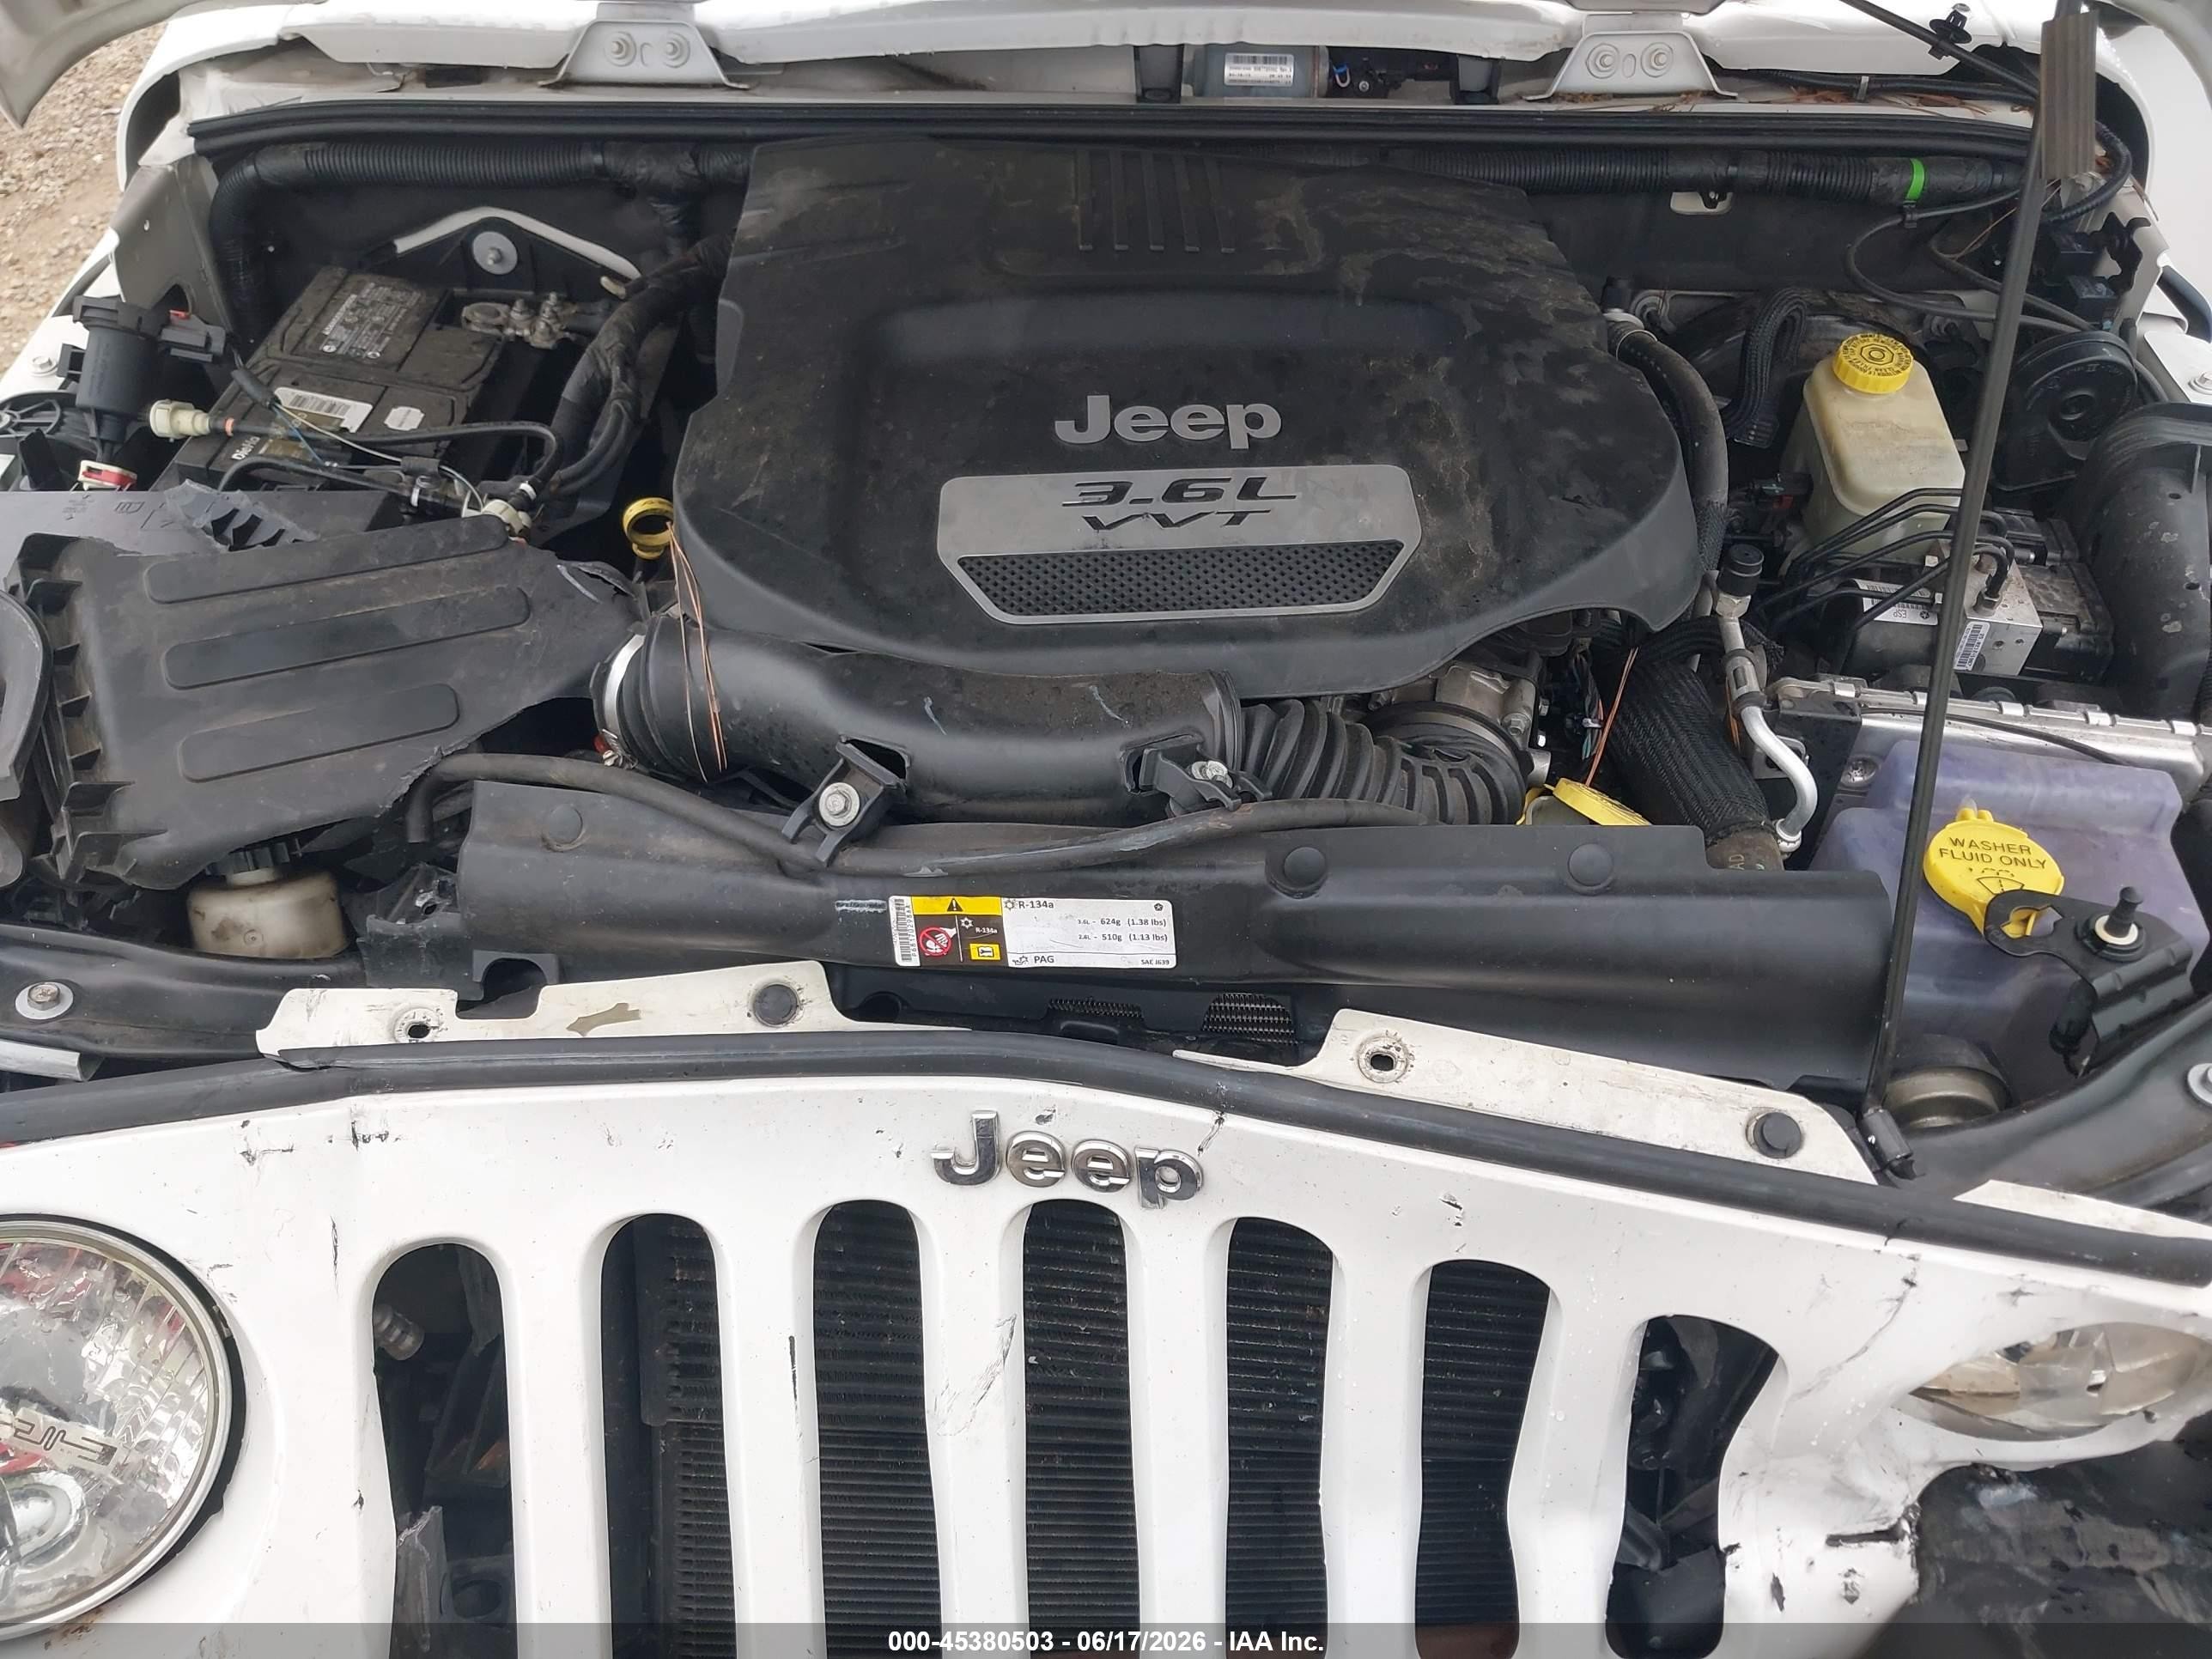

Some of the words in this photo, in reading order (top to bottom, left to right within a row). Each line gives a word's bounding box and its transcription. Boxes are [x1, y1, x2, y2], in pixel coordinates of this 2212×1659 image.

[1054, 394, 1282, 450] Jeep
[1061, 477, 1297, 507] 3.6L
[1082, 509, 1271, 531] VVT
[1949, 836, 2032, 855] WASHER
[1939, 848, 1993, 863] FLUID
[1999, 854, 2046, 869] ONLY
[1018, 900, 1054, 909] R-134a
[1100, 918, 1121, 927] 624g
[1127, 918, 1149, 927] (1.38
[1151, 918, 1167, 927] lbs)
[1102, 933, 1122, 942] 510g
[1128, 933, 1150, 942] (1.13
[1152, 933, 1168, 943] lbs)
[1034, 955, 1054, 963] PAG
[930, 1109, 1204, 1210] Jeep
